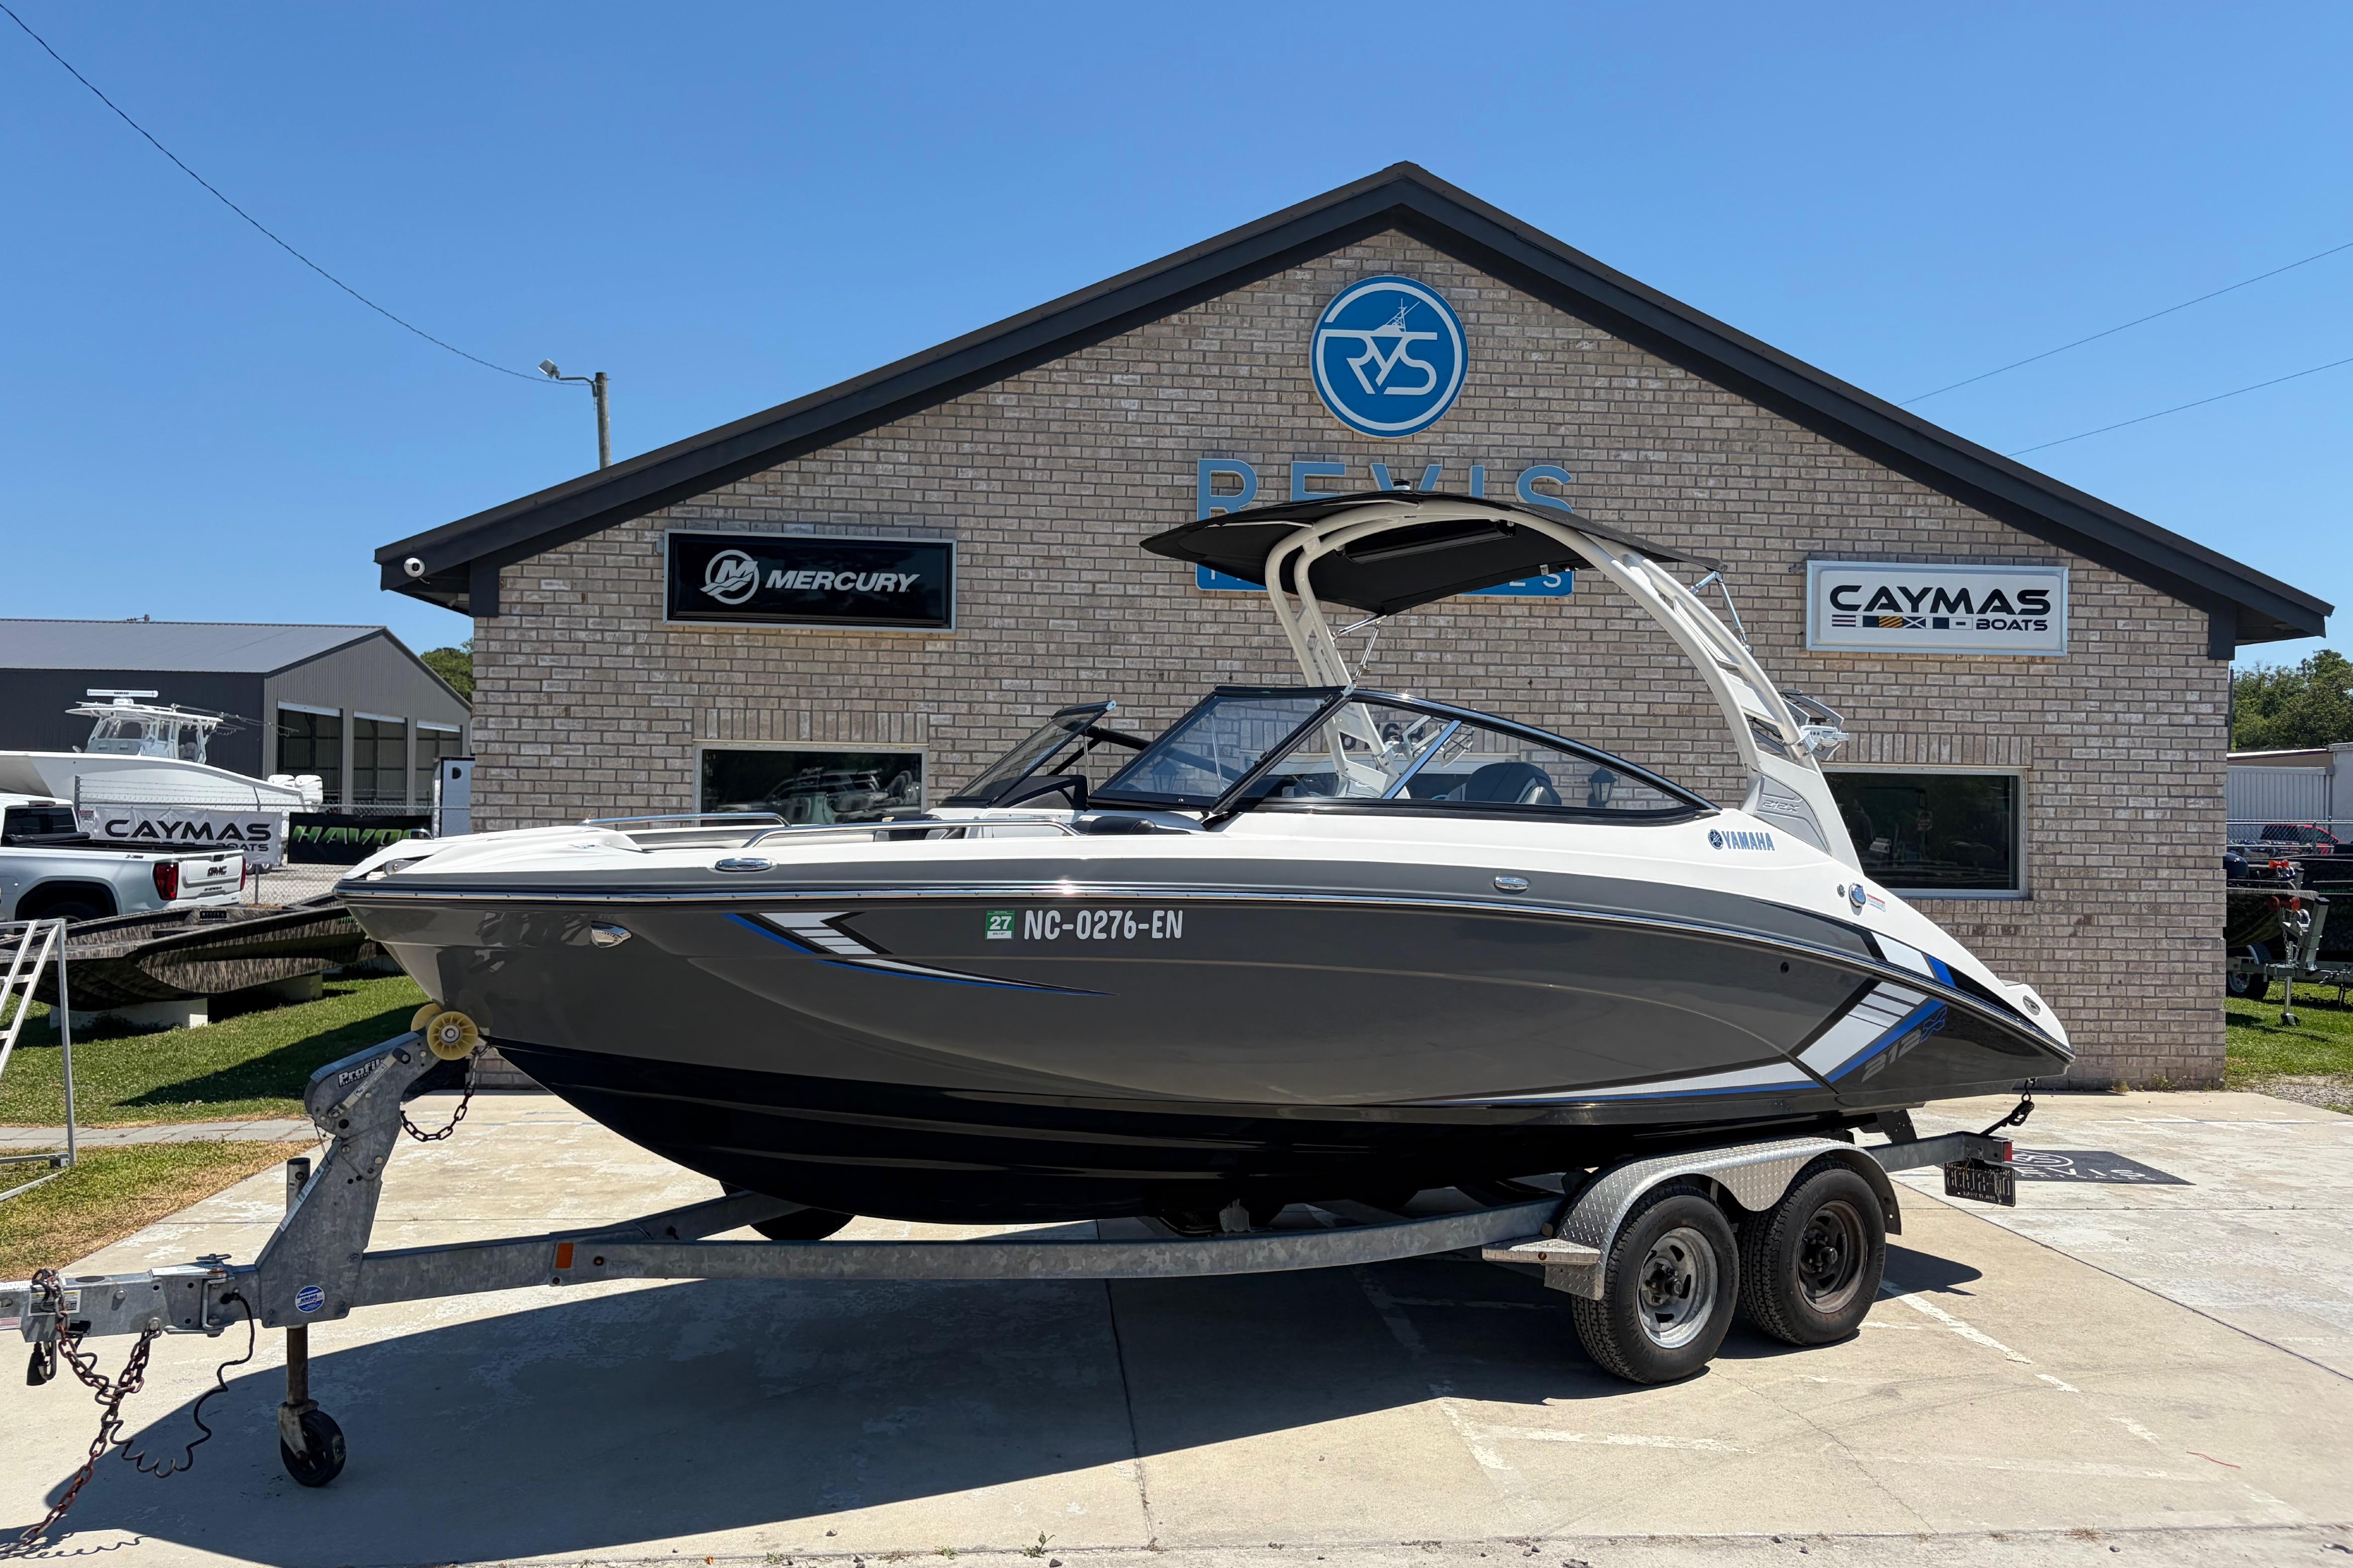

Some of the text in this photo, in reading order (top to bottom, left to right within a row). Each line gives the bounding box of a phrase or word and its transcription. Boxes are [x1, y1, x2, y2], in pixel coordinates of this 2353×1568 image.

[765, 570, 920, 592] MERCURY
[1830, 585, 2051, 615] CAYMAS
[1976, 618, 2048, 631] BOATS
[1762, 800, 1800, 813] 212X
[105, 819, 271, 841] CAYMAS
[1721, 830, 1775, 851] YAMAHA
[990, 916, 1012, 930] 27
[1024, 910, 1183, 940] NC-0276-EN
[2014, 1167, 2146, 1176] EVIS
